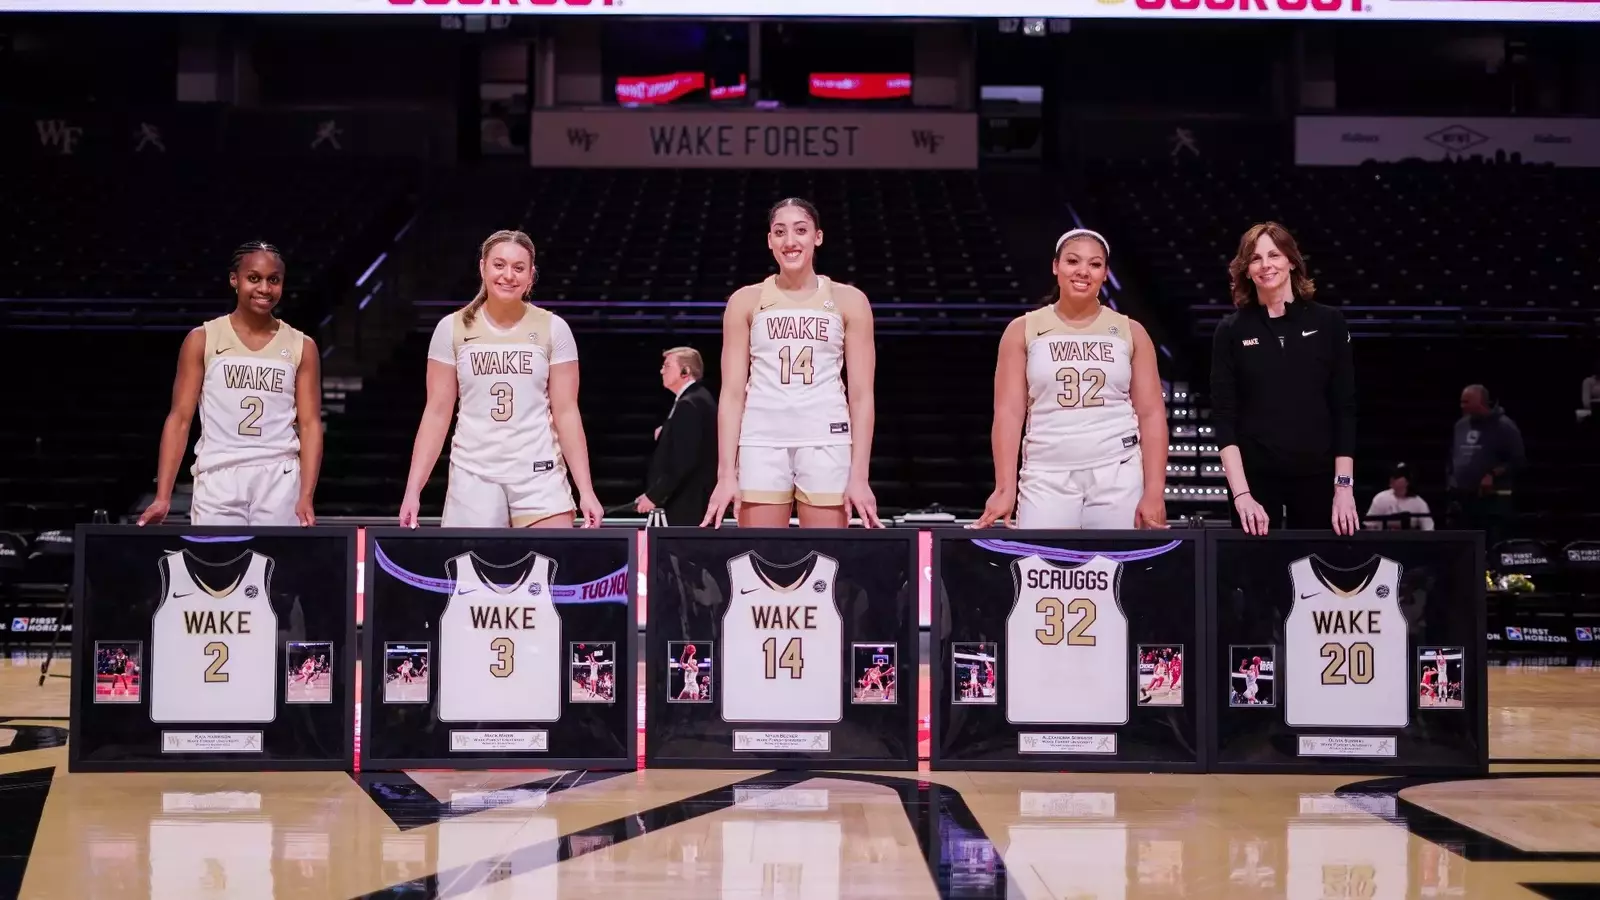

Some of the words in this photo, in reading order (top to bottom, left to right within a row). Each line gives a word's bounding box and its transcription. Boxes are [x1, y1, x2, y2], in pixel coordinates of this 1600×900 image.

[34, 118, 84, 155] WF
[566, 127, 599, 152] WF
[650, 126, 733, 156] WAKE
[745, 126, 859, 156] FOREST
[911, 129, 944, 153] WF
[767, 316, 830, 342] WAKE
[1242, 337, 1260, 346] WAKE
[470, 350, 533, 376] WAKE
[778, 345, 815, 385] 14
[1048, 341, 1115, 363] WAKE
[223, 364, 286, 394] WAKE
[1055, 366, 1107, 408] 32
[489, 381, 514, 422] 3
[237, 395, 264, 437] 2
[1027, 569, 1109, 591] SCRUGGS
[184, 610, 252, 635] WAKE
[469, 606, 536, 630] WAKE
[751, 605, 818, 630] WAKE
[1035, 597, 1097, 647] 32
[1312, 610, 1382, 635] WAKE
[1523, 628, 1549, 636] FIRST
[204, 641, 229, 683] 2
[489, 637, 514, 678] 3
[762, 637, 804, 680] 14
[1320, 641, 1375, 686] 20
